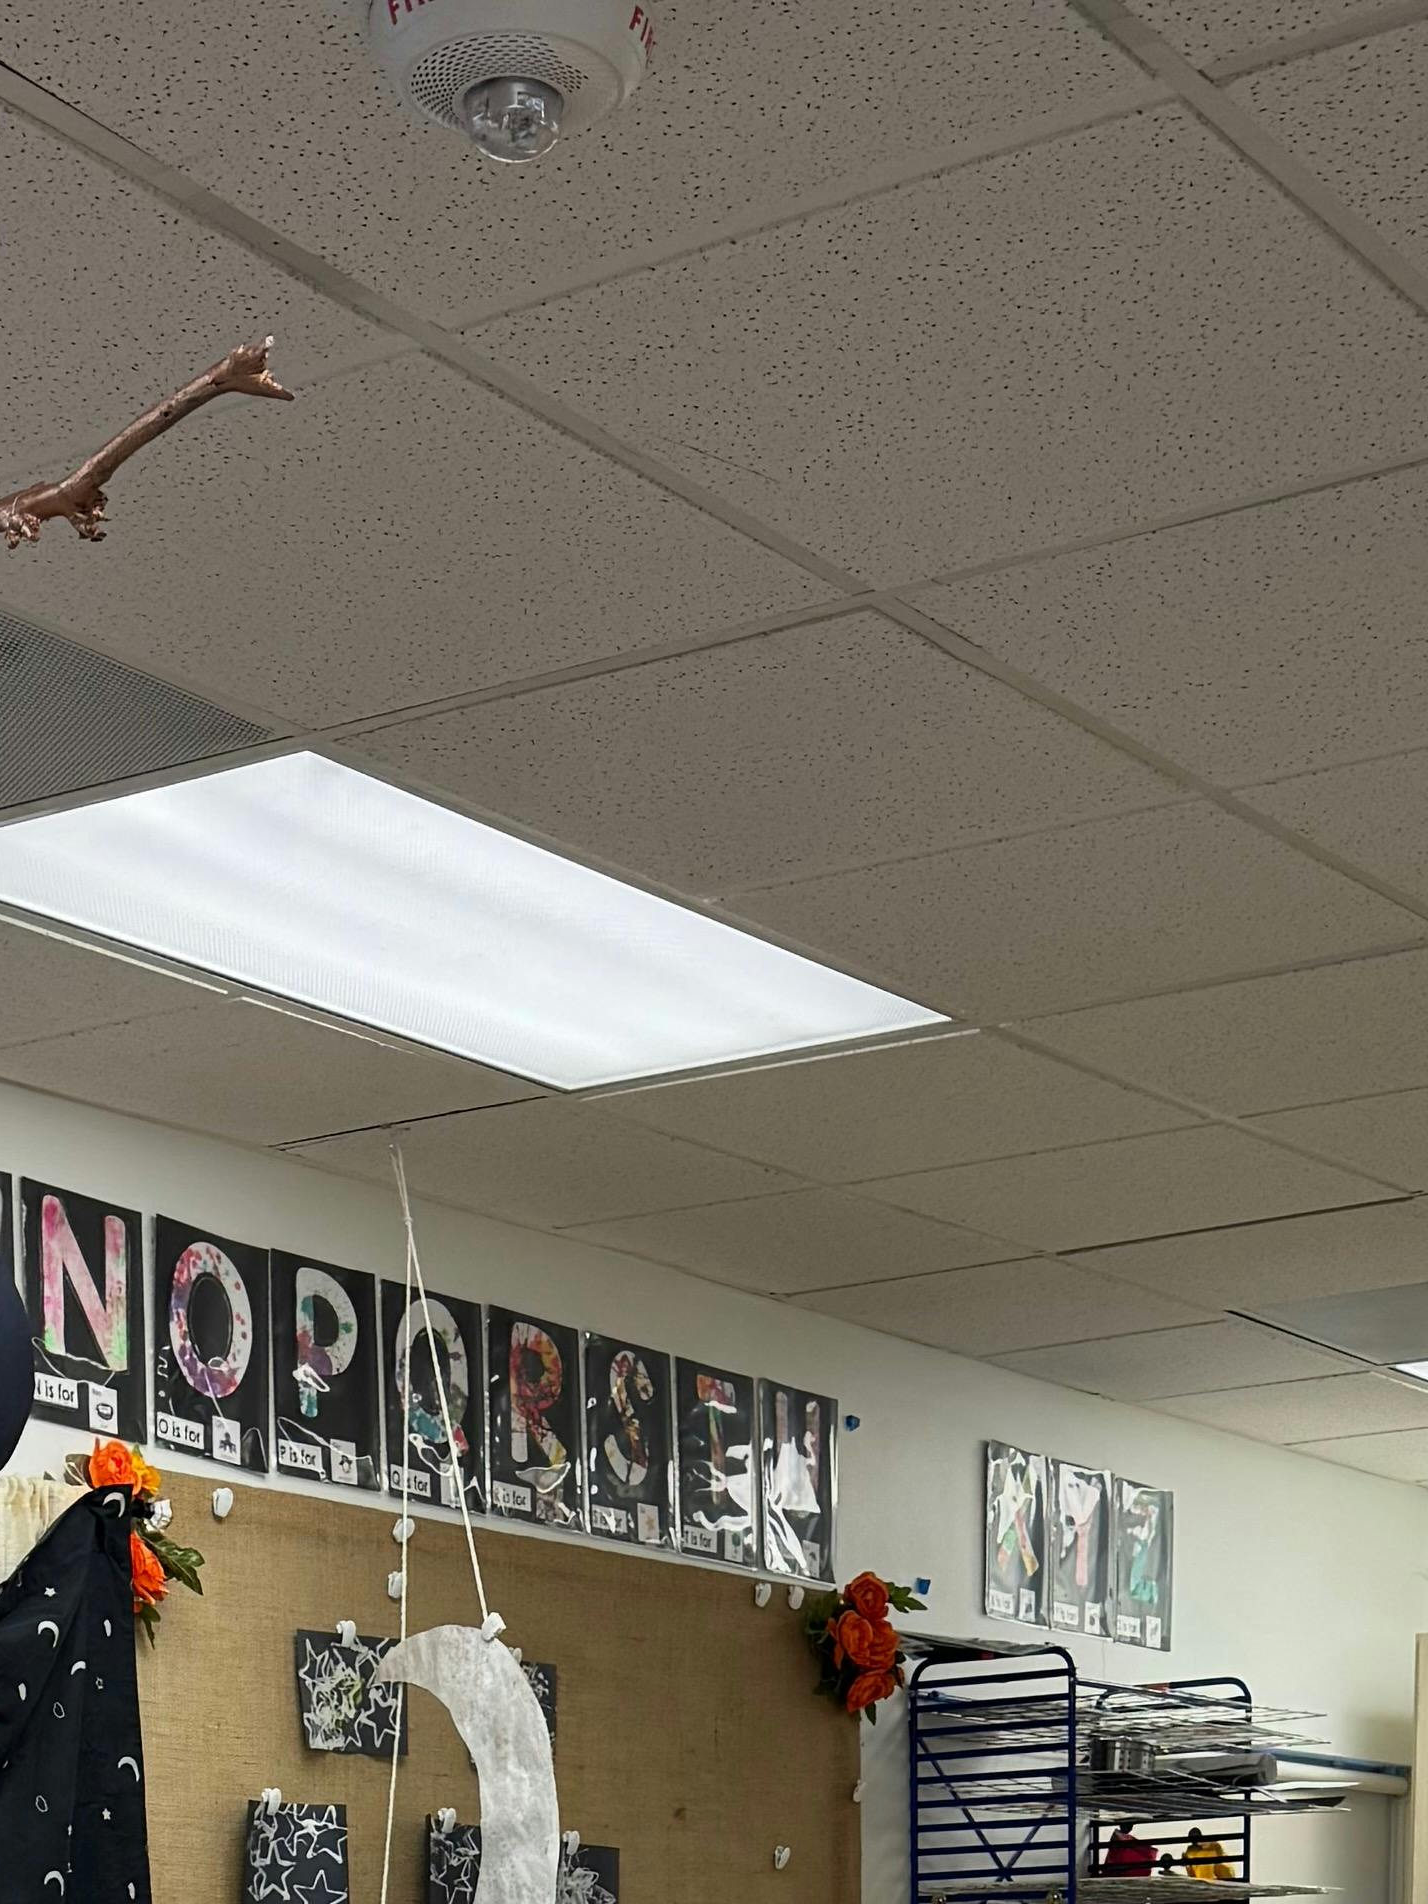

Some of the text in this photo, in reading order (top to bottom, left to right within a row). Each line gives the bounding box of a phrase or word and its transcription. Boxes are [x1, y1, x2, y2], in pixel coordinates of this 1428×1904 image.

[379, 0, 434, 25] FI
[41, 1193, 129, 1372] N
[169, 1241, 253, 1399] O
[295, 1266, 359, 1418] P
[44, 1377, 57, 1401] is
[57, 1377, 75, 1404] for
[182, 1419, 201, 1444] for
[299, 1447, 317, 1468] for
[509, 1321, 568, 1472] R
[604, 1350, 653, 1486] S
